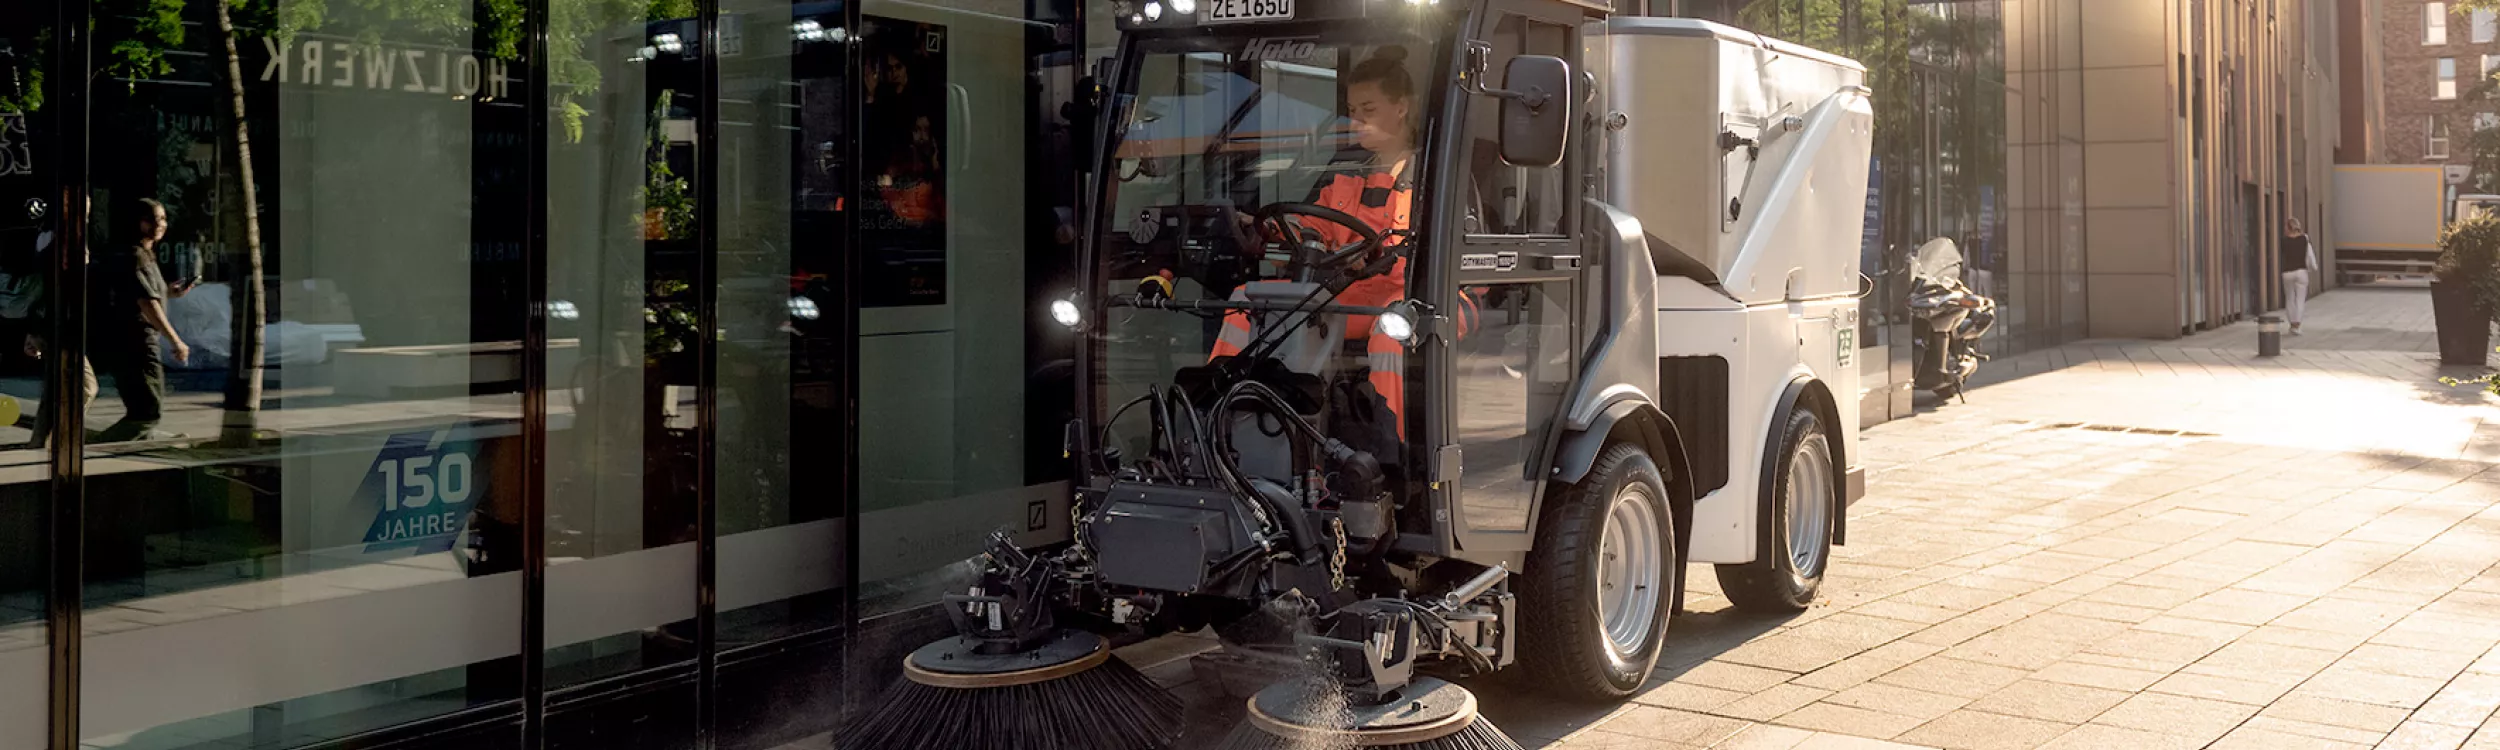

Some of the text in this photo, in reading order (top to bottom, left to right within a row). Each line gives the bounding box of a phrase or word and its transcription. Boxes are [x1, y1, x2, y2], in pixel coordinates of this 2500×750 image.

[1213, 0, 1236, 18] ZE
[1240, 36, 1316, 61] Hako
[378, 452, 472, 512] 150
[377, 512, 455, 541] JAHRE
